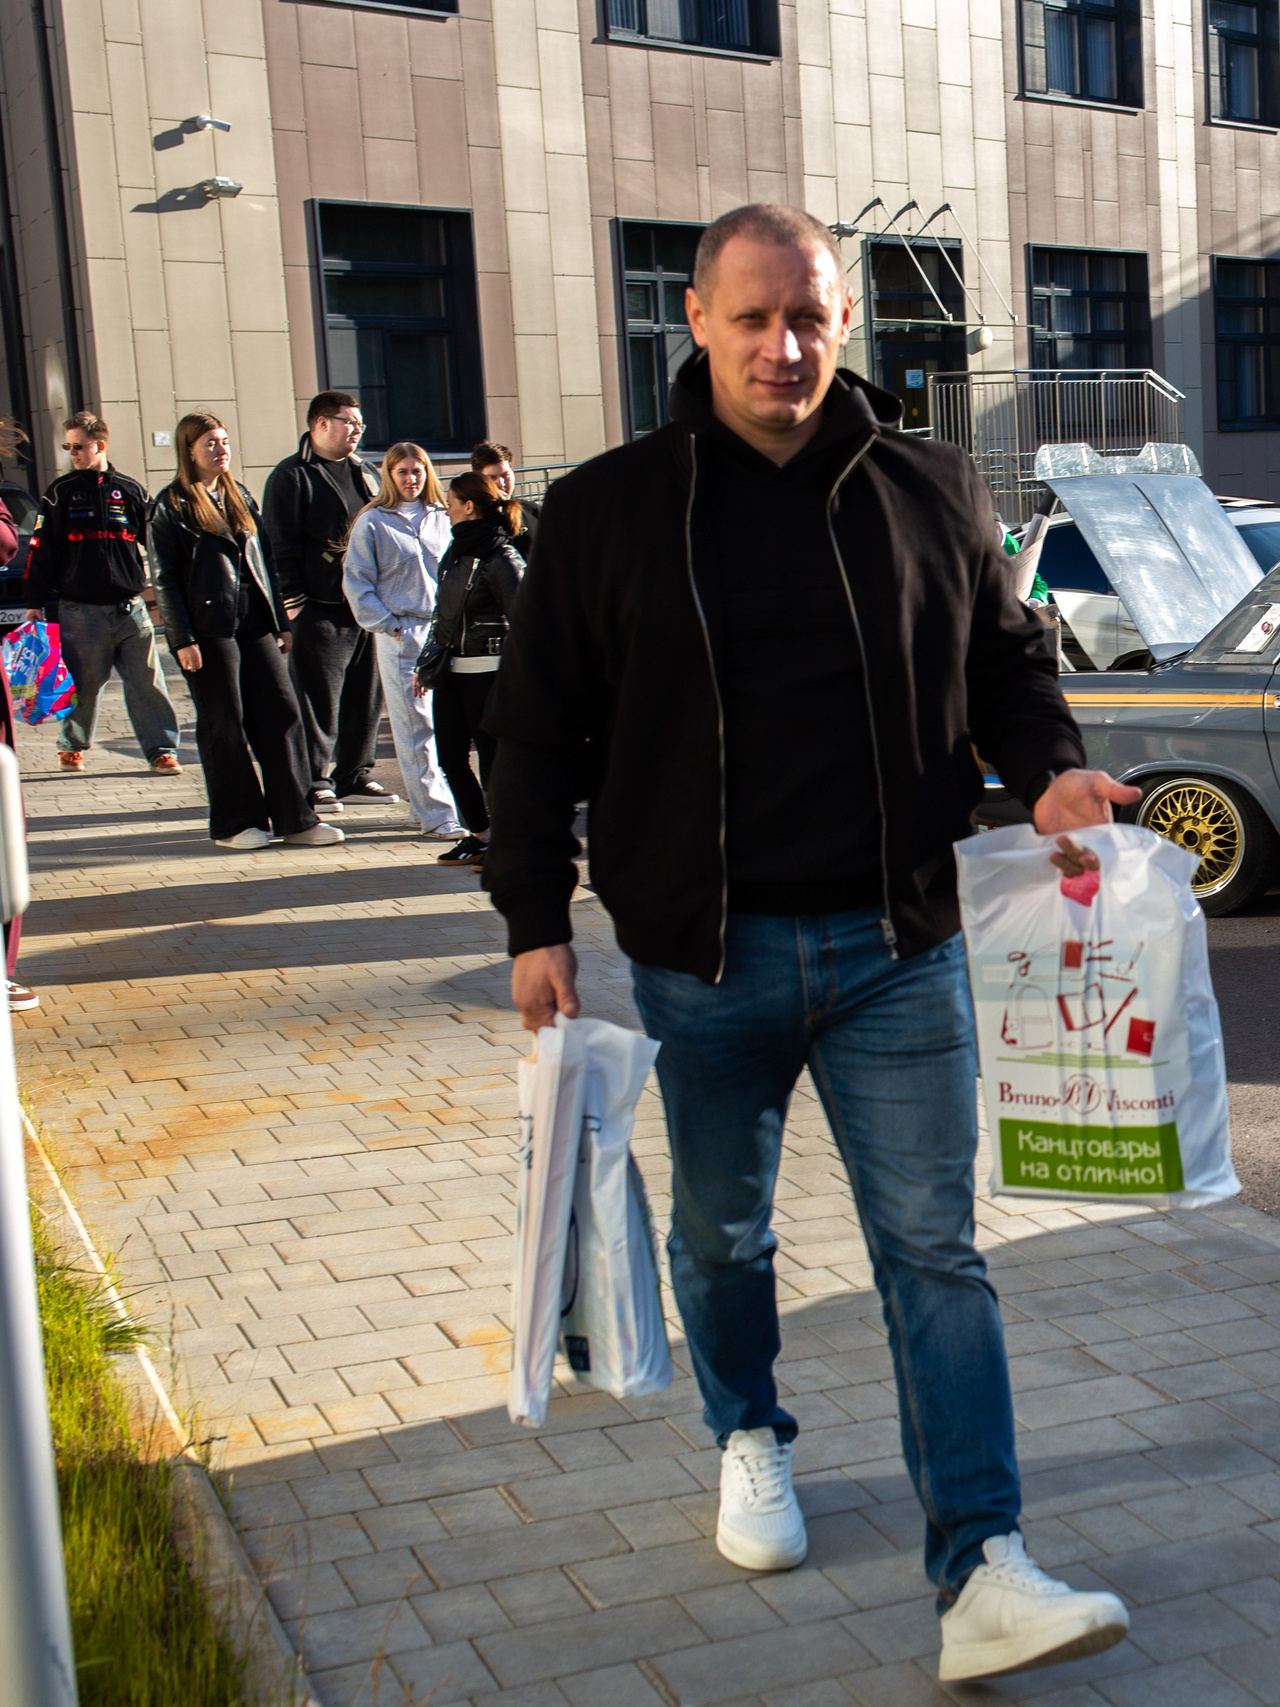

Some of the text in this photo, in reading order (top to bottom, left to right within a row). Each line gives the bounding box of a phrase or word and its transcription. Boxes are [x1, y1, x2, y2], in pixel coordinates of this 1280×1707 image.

[999, 1082, 1058, 1107] Bruno
[1018, 1130, 1161, 1162] Канцтовары
[1020, 1161, 1164, 1184] на отлично!
